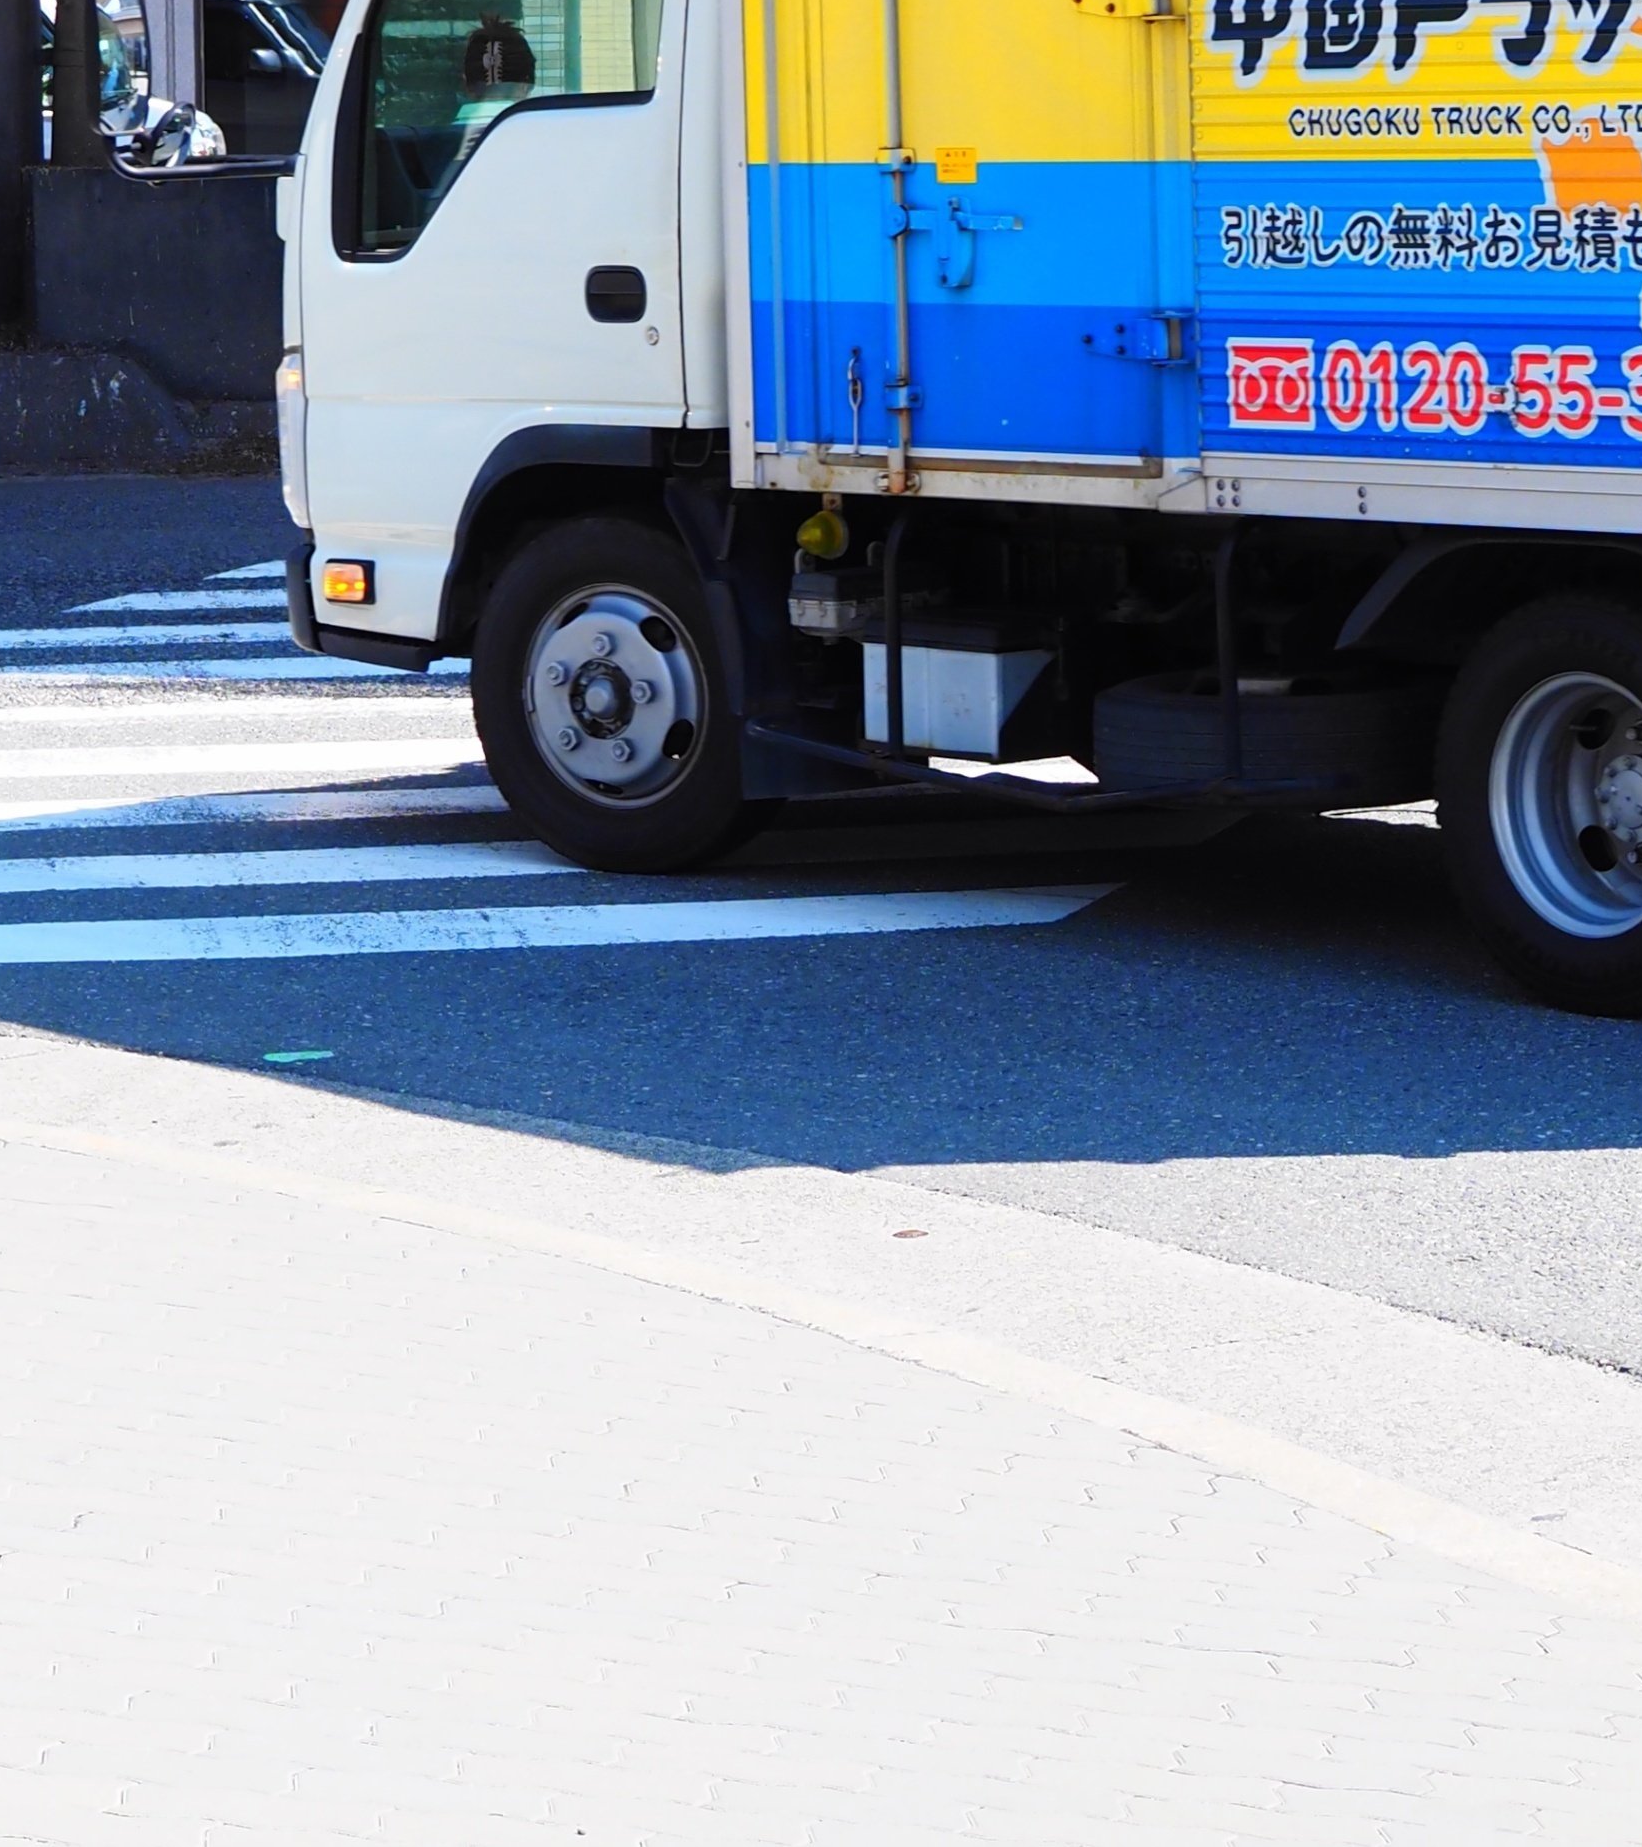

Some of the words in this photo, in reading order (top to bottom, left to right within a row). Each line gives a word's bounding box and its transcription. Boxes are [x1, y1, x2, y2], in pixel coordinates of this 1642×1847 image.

[1288, 107, 1420, 137] CHUGOKU
[1432, 105, 1520, 136] TRUCK
[1531, 105, 1591, 141] CO.,
